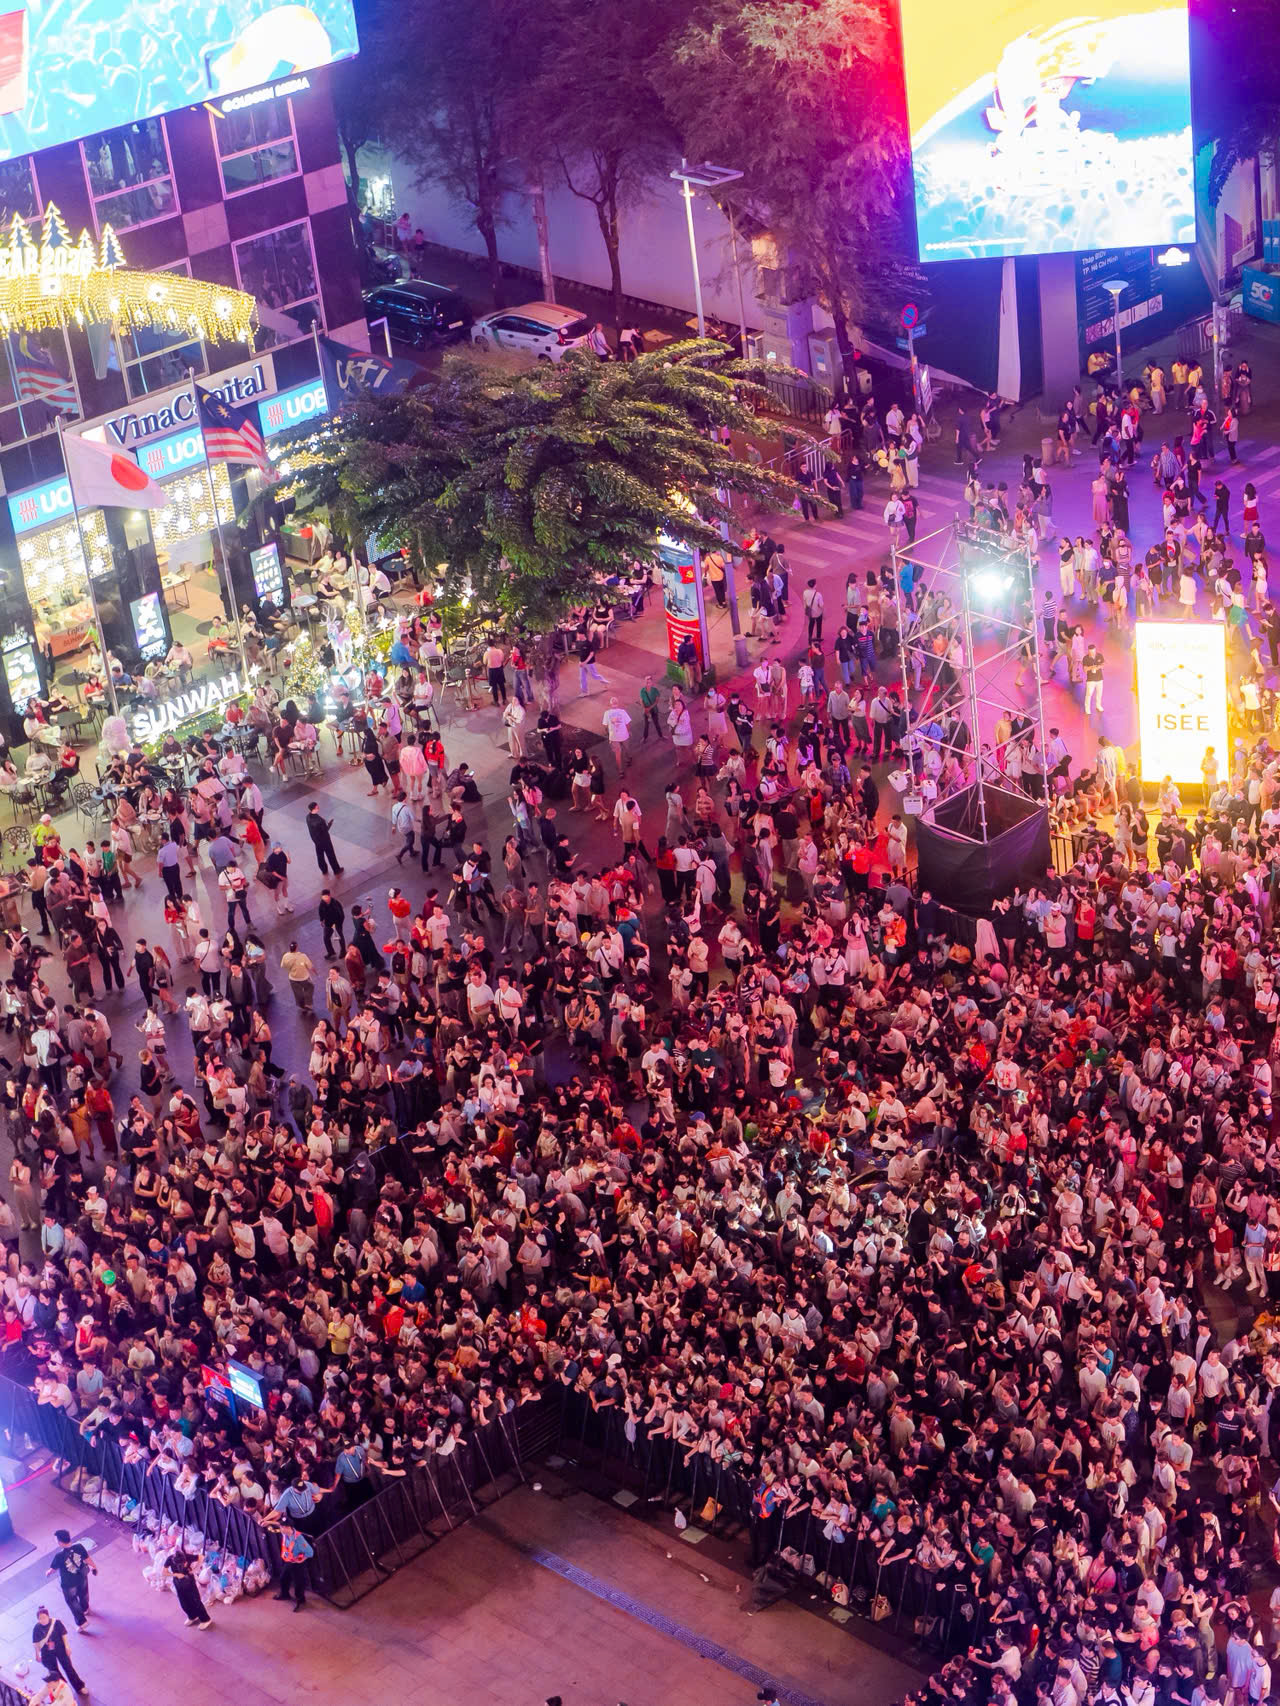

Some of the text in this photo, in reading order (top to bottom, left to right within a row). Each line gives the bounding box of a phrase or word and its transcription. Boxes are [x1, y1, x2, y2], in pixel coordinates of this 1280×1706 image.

[104, 363, 268, 446] VinaCpital
[40, 484, 75, 513] UO
[133, 671, 240, 738] SUNWAH
[1156, 713, 1210, 732] ISEE
